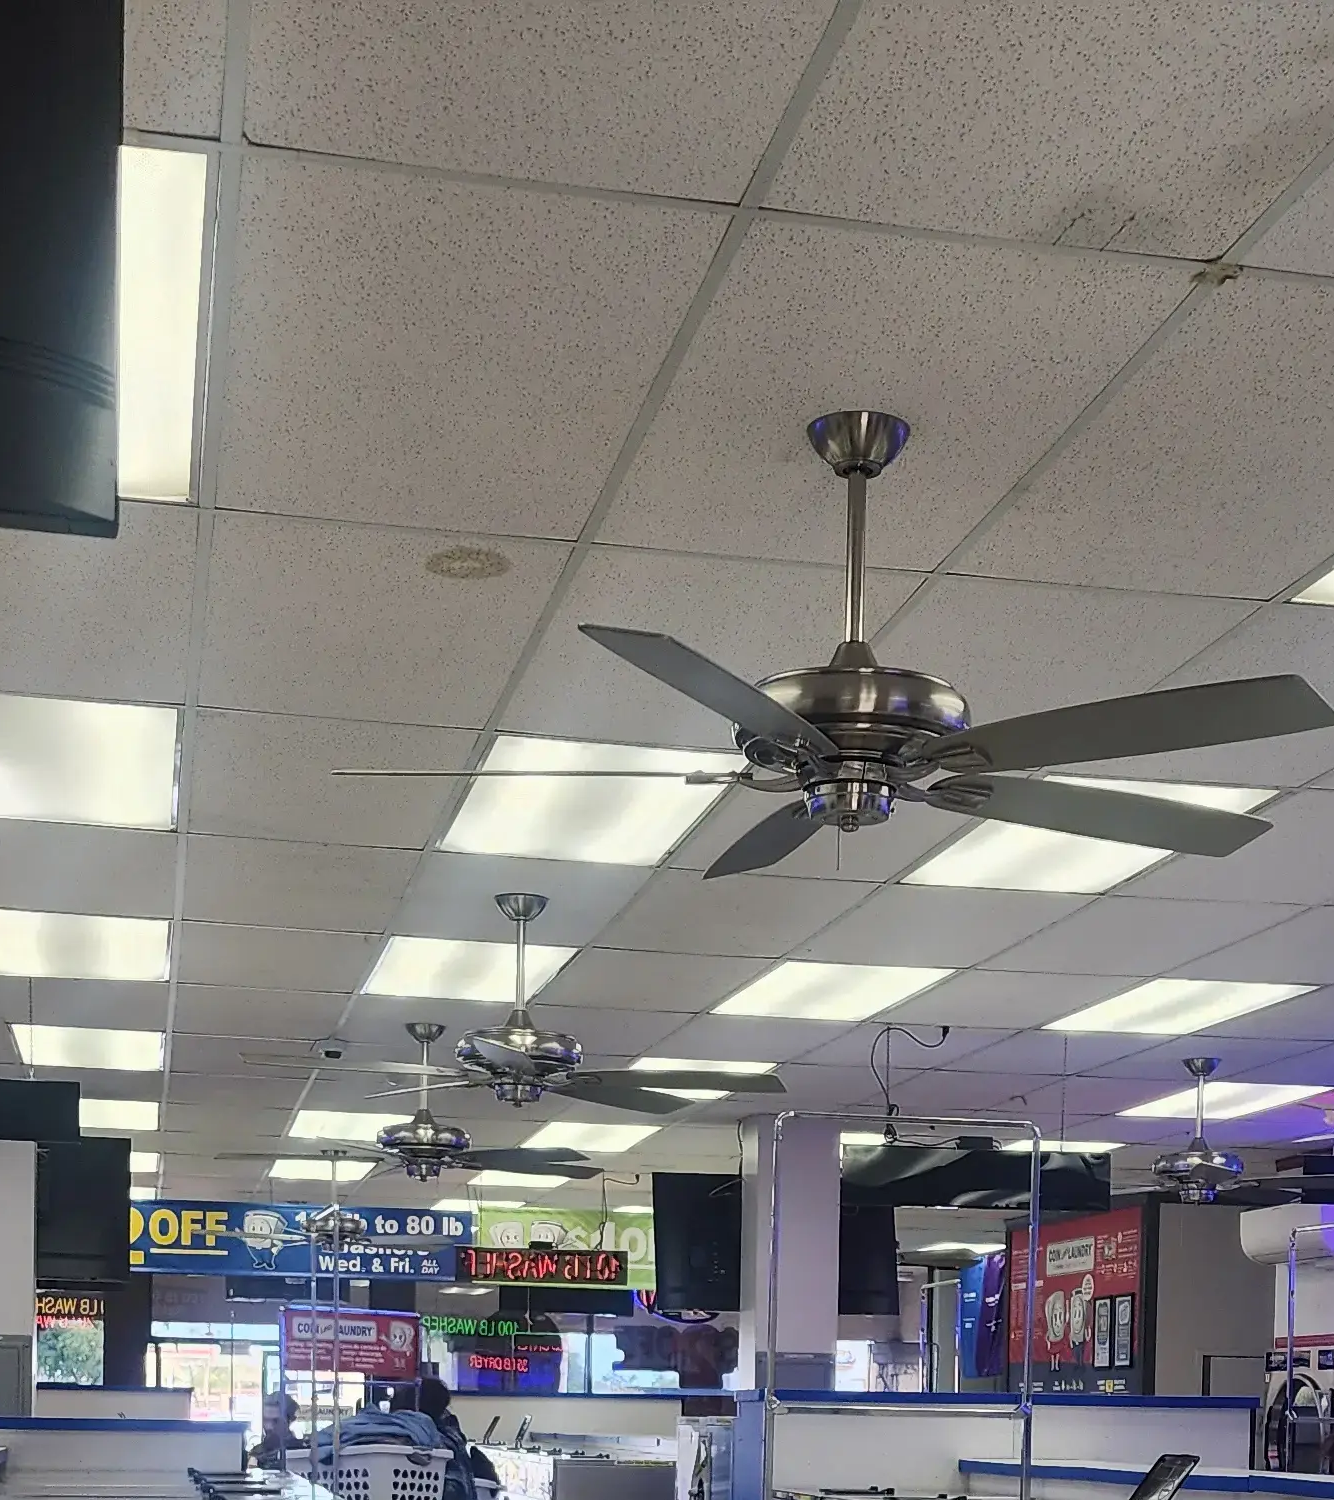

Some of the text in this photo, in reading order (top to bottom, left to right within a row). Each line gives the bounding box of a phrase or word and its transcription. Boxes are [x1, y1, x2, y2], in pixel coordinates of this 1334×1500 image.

[148, 1208, 228, 1246] OFF
[375, 1214, 399, 1234] to
[406, 1215, 434, 1236] 80
[443, 1217, 463, 1236] lb
[318, 1255, 415, 1274] Wed. & Fri.
[421, 1259, 438, 1268] ALL
[421, 1266, 440, 1275] DAY
[297, 1322, 320, 1335] CON
[337, 1323, 373, 1337] AUNDRY
